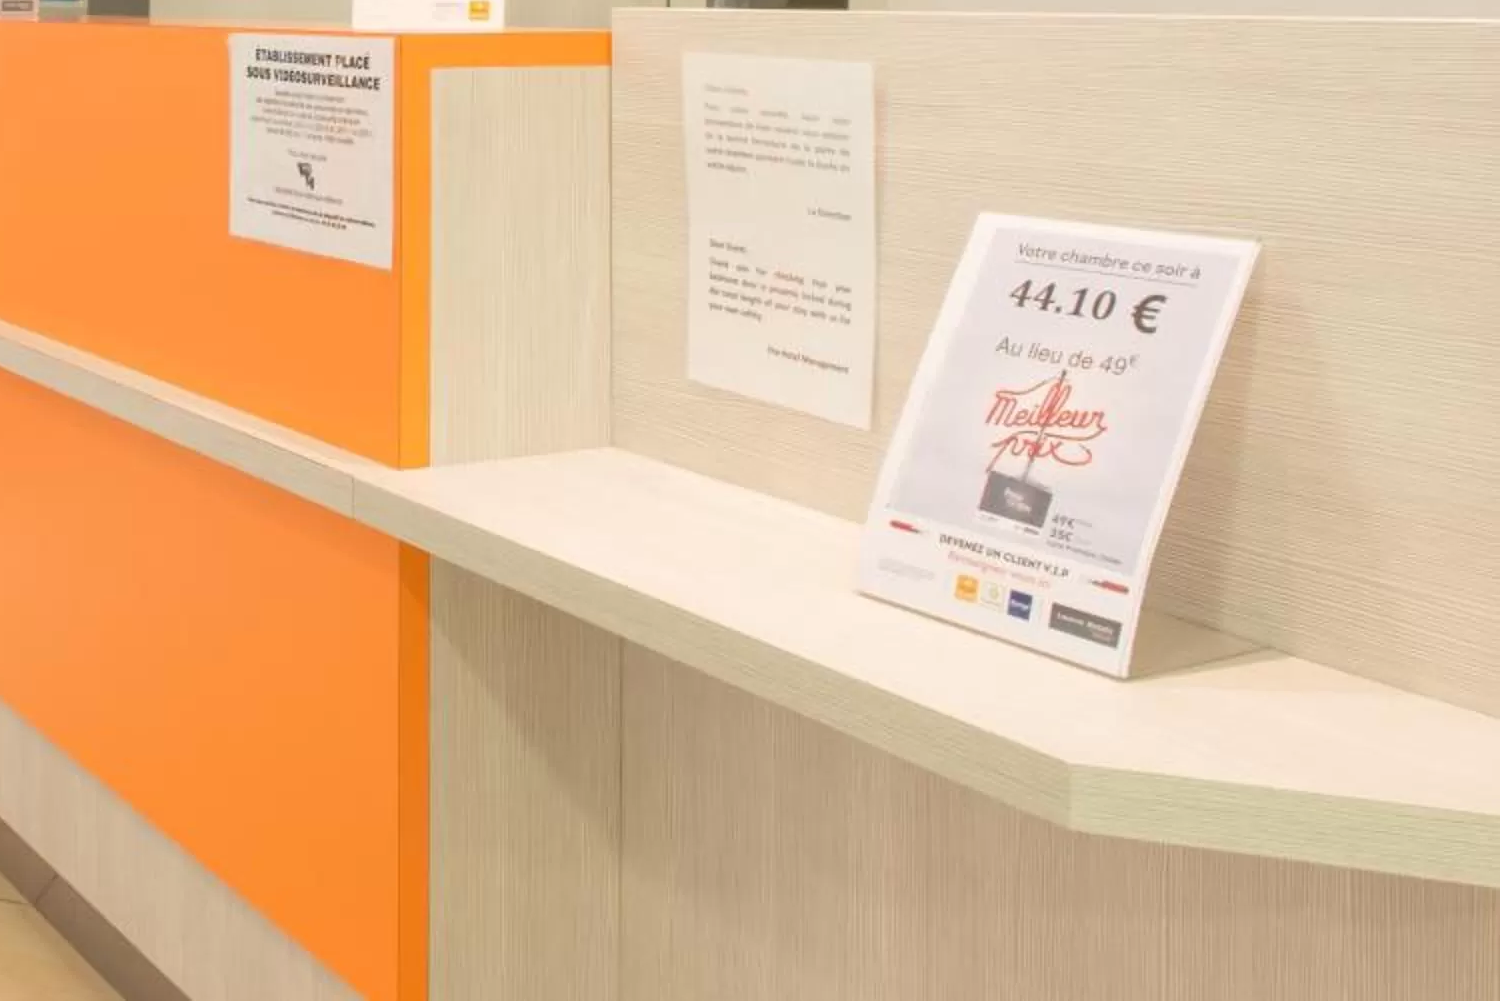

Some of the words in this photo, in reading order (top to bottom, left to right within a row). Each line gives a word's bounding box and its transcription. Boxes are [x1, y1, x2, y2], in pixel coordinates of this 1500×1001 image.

[246, 65, 272, 81] SOUS
[1017, 242, 1058, 262] Votre
[1060, 249, 1129, 272] chambre
[1131, 259, 1153, 274] ce
[1155, 262, 1188, 280] soir
[1008, 277, 1118, 322] 44.10
[1130, 293, 1169, 335] €
[995, 335, 1024, 358] Au
[1027, 341, 1063, 365] lieu
[1067, 349, 1094, 371] de
[985, 377, 1108, 432] Meilleur
